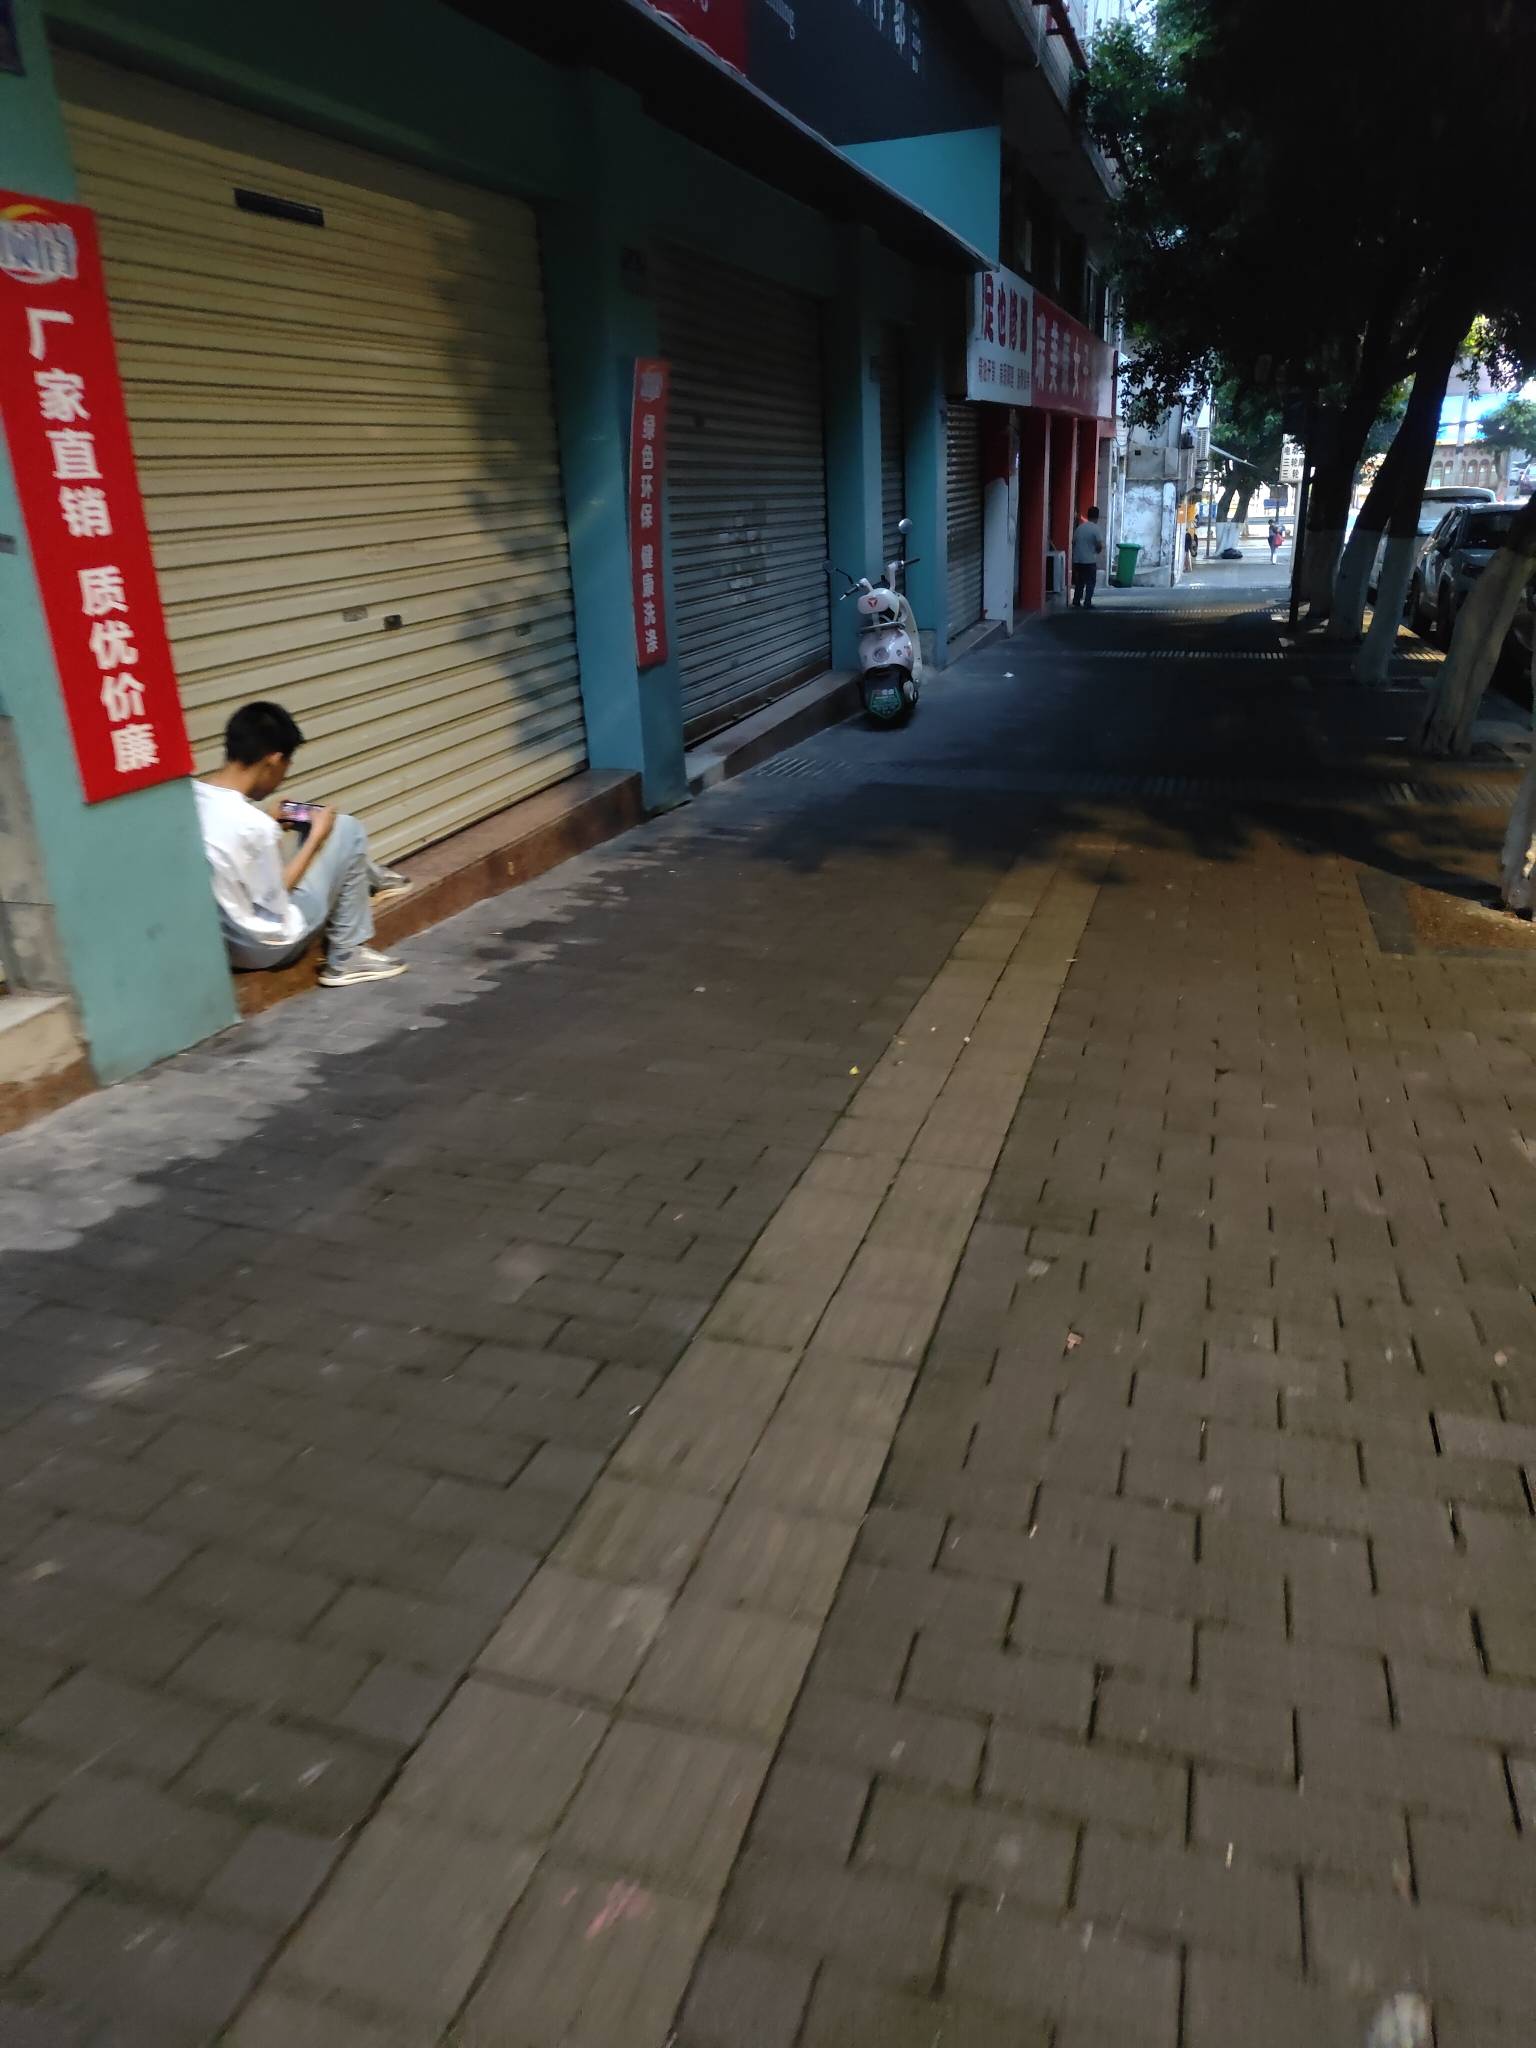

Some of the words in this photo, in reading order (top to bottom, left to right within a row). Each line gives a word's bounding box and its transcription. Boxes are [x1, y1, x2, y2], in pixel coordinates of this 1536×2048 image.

[26, 307, 113, 539] 厂家直销
[77, 564, 160, 773] 质优价廉
[639, 413, 656, 529] 绿色环保
